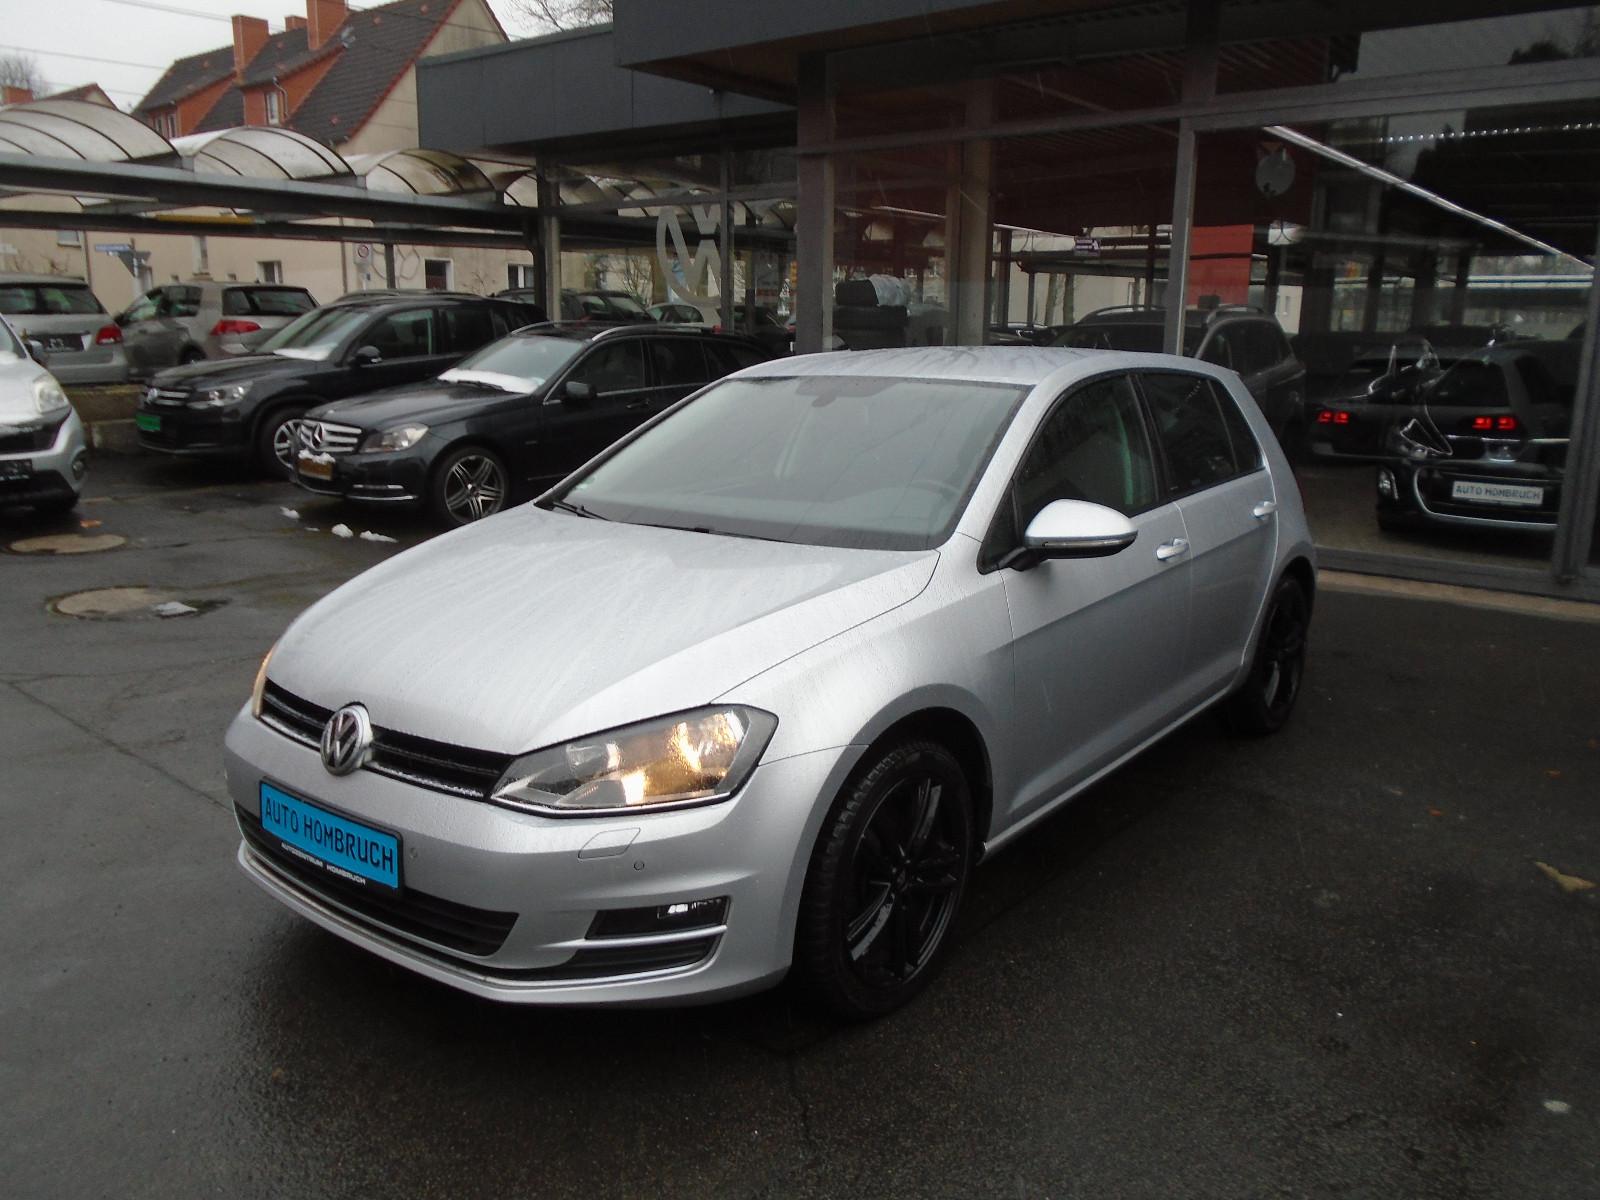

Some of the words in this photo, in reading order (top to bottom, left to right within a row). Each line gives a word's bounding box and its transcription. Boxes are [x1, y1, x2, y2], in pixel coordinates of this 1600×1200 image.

[1456, 485, 1482, 495] AUTO
[1485, 488, 1540, 500] HOMBRUCH
[265, 797, 298, 833] AUTO
[303, 815, 393, 873] HOMBRUCH
